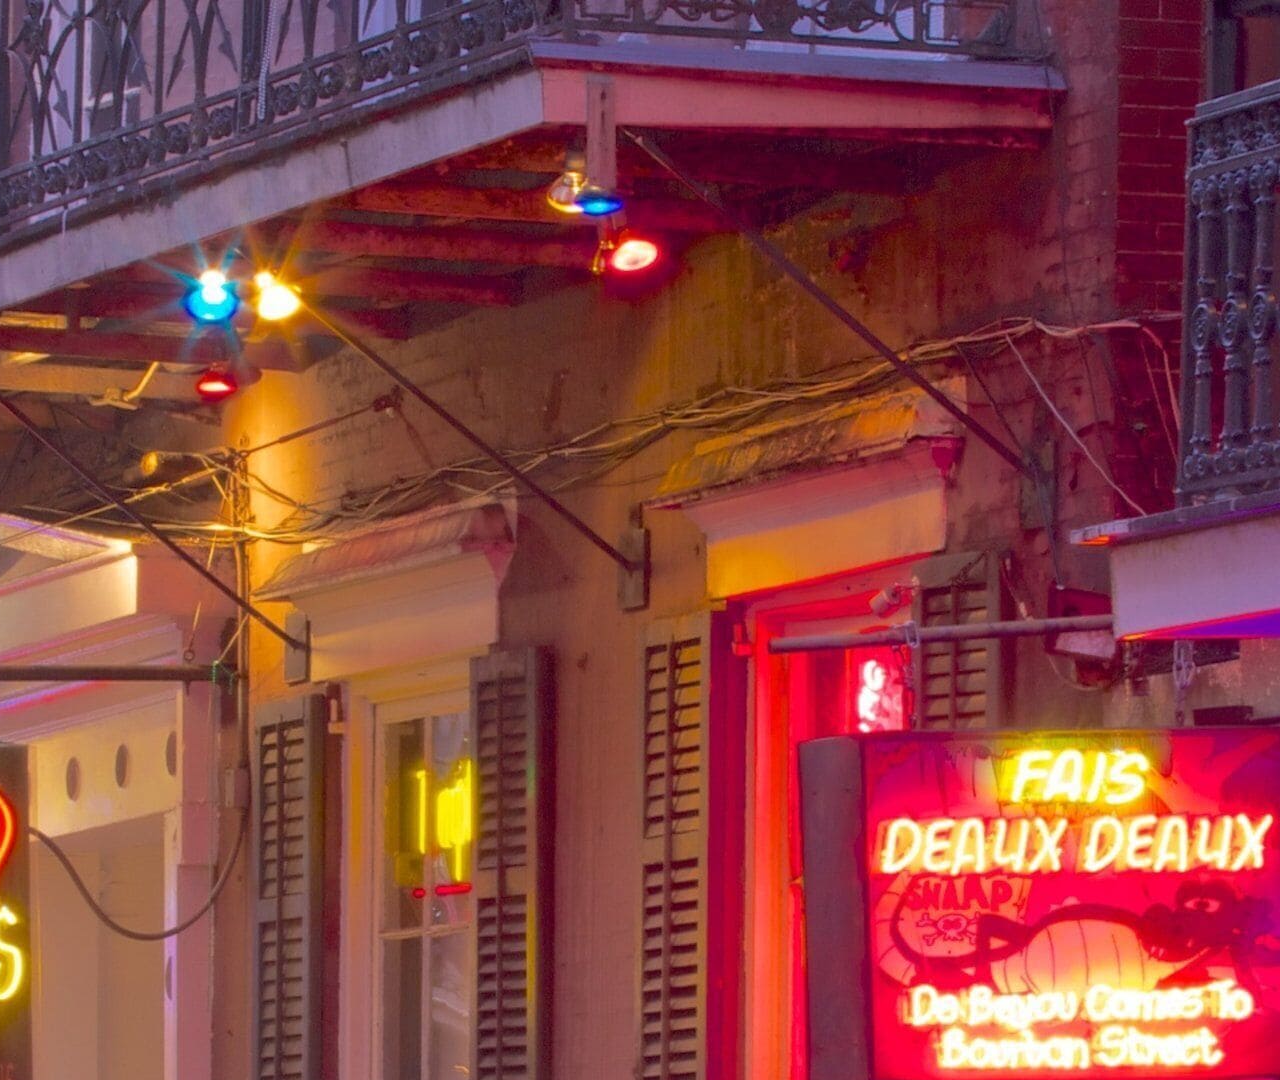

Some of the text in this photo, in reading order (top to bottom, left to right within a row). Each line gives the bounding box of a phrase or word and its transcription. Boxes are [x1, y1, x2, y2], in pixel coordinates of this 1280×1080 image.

[1012, 749, 1152, 804] FAIS
[881, 814, 1272, 874] DEAUX DEAUX
[969, 983, 1078, 1030] Bayou
[1084, 983, 1205, 1022] Comes
[1214, 979, 1254, 1020] To
[937, 1025, 1225, 1070] Bourbon Street
